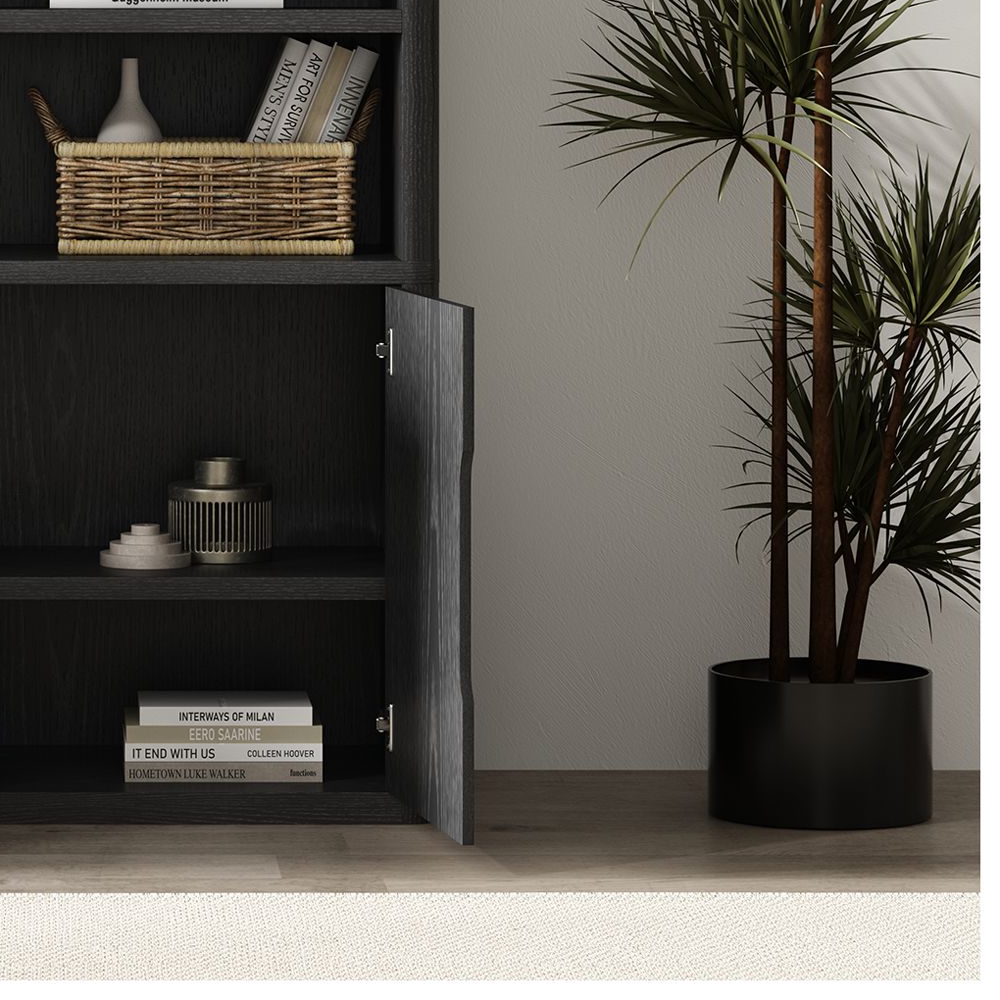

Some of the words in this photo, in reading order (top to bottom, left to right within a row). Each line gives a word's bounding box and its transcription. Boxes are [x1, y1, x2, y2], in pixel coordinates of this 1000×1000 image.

[306, 52, 323, 77] ART
[269, 58, 297, 106] MEN'S
[294, 78, 314, 103] FOR
[179, 712, 229, 721] INTERWAYS
[232, 712, 243, 721] OF
[246, 712, 275, 721] MILAN
[189, 729, 215, 741] EERO
[218, 729, 261, 741] SAARINE
[132, 749, 142, 759] IT
[145, 749, 168, 759] END
[171, 749, 198, 759] WITH
[201, 749, 215, 759] US
[247, 750, 282, 758] COLLEEN
[284, 750, 314, 758] HOOVER
[129, 769, 182, 779] HOMETOWN
[184, 769, 207, 779] LUKE
[209, 769, 246, 779] WALKER
[290, 769, 317, 777] functions
